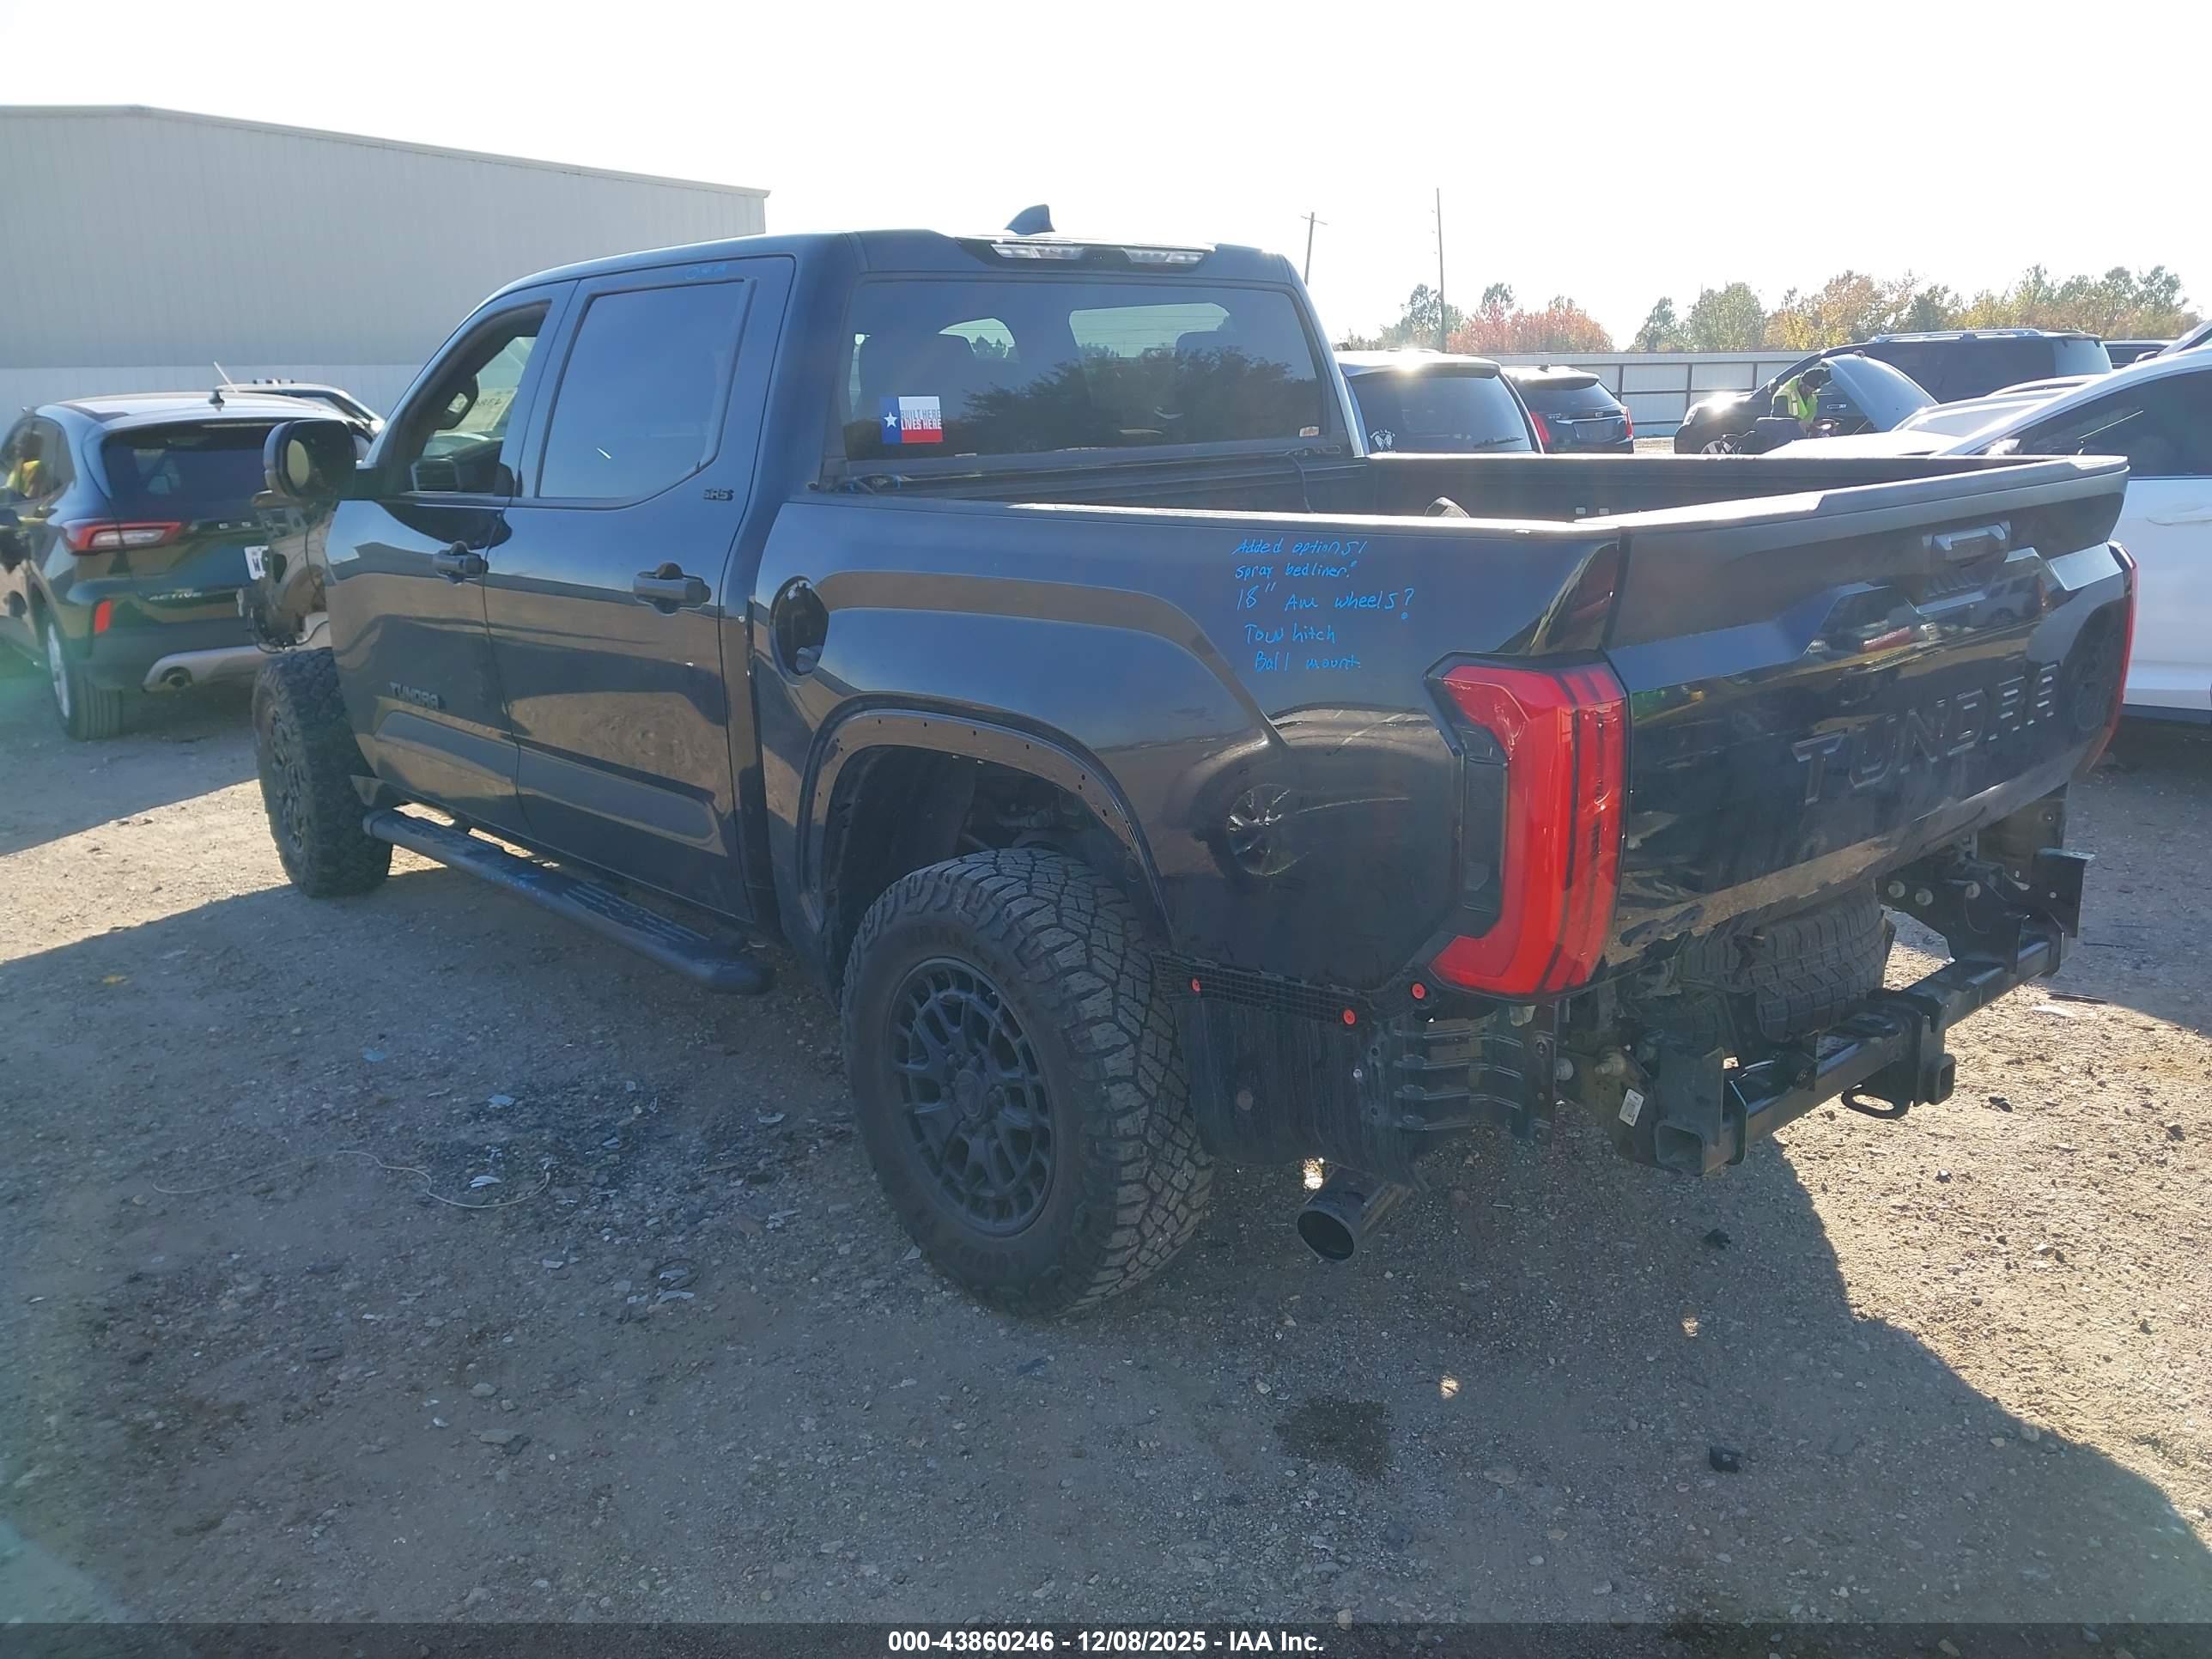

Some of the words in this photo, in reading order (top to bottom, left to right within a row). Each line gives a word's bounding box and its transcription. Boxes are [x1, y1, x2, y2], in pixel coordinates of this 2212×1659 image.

[922, 408, 941, 419] HERE
[900, 419, 921, 431] LIVES
[922, 418, 943, 430] HERE
[1232, 538, 1284, 555] Added
[1235, 564, 1273, 580] spray
[1245, 623, 1284, 644] Tow
[1291, 622, 1336, 644] hitch
[1254, 651, 1289, 672] Ball
